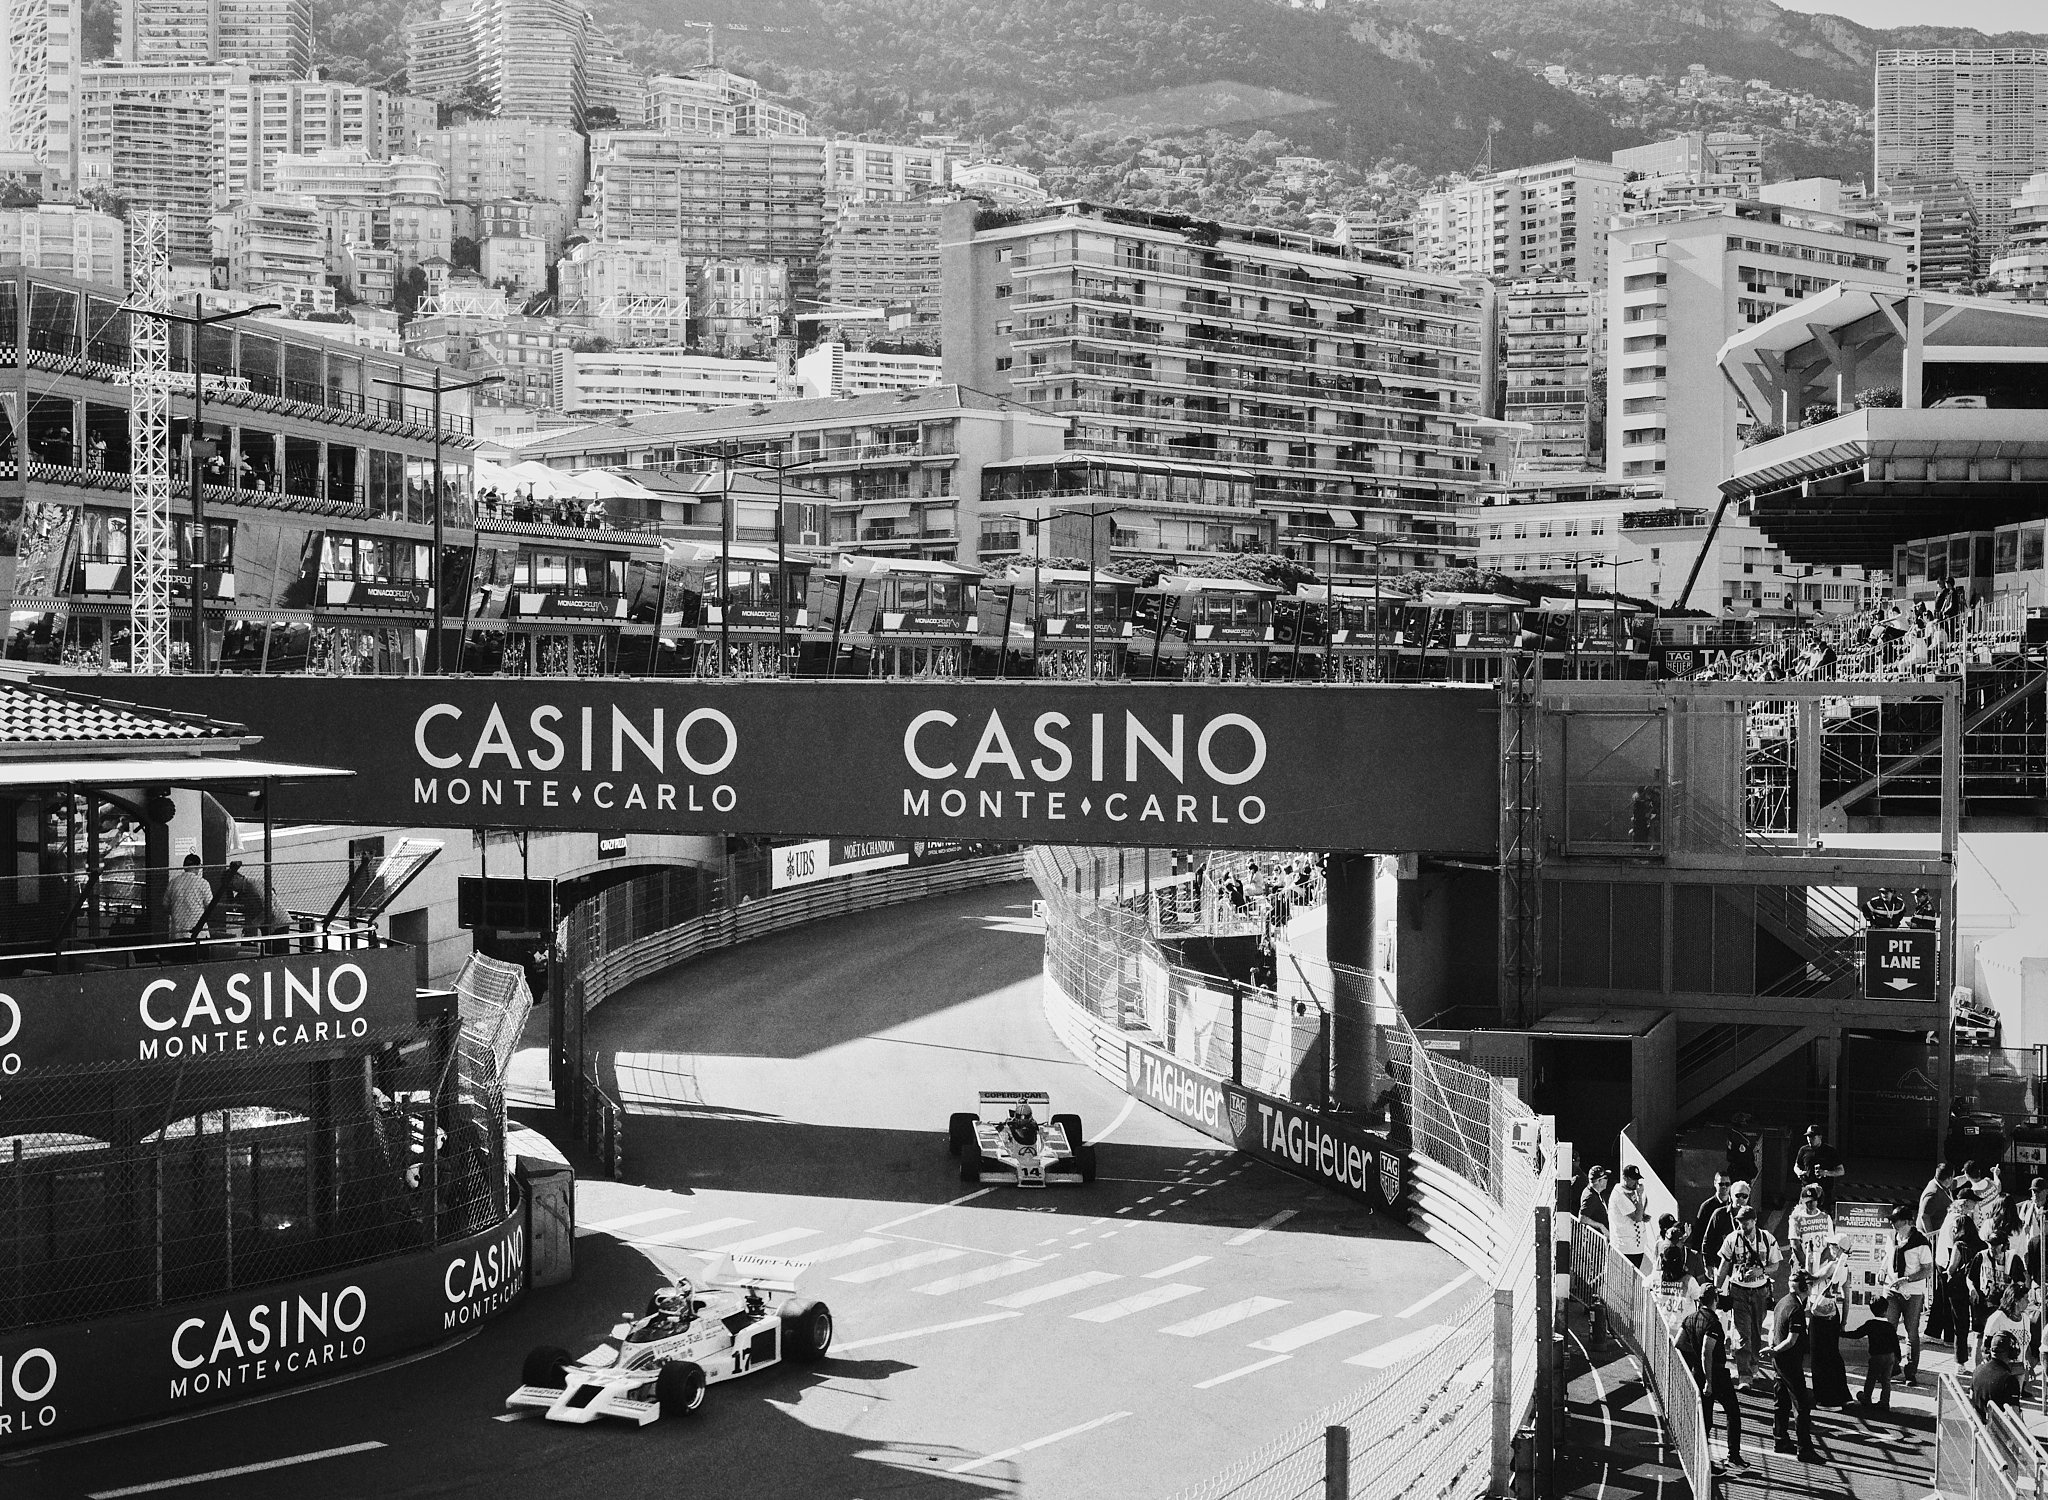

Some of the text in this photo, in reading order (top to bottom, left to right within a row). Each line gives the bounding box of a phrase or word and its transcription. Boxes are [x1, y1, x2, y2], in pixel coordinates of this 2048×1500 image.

[1668, 652, 1691, 660] TAG
[414, 701, 737, 775] CASINO
[903, 708, 1267, 785] CASINO
[414, 778, 737, 812] MONTE CARLO
[903, 789, 1266, 824] MONTE CARLO
[795, 849, 815, 878] UBS
[1881, 956, 1921, 969] LANE
[1889, 940, 1913, 953] PIT
[139, 963, 368, 1031] CASINO
[139, 1017, 368, 1060] MONTE CARLO
[1021, 1167, 1041, 1177] 14
[1381, 1154, 1398, 1177] TAG
[445, 1225, 523, 1303] CASINO
[171, 1285, 366, 1369] CASINO
[445, 1293, 498, 1330] MONTE
[170, 1336, 366, 1399] MONTE CARLO
[732, 1347, 752, 1374] 17
